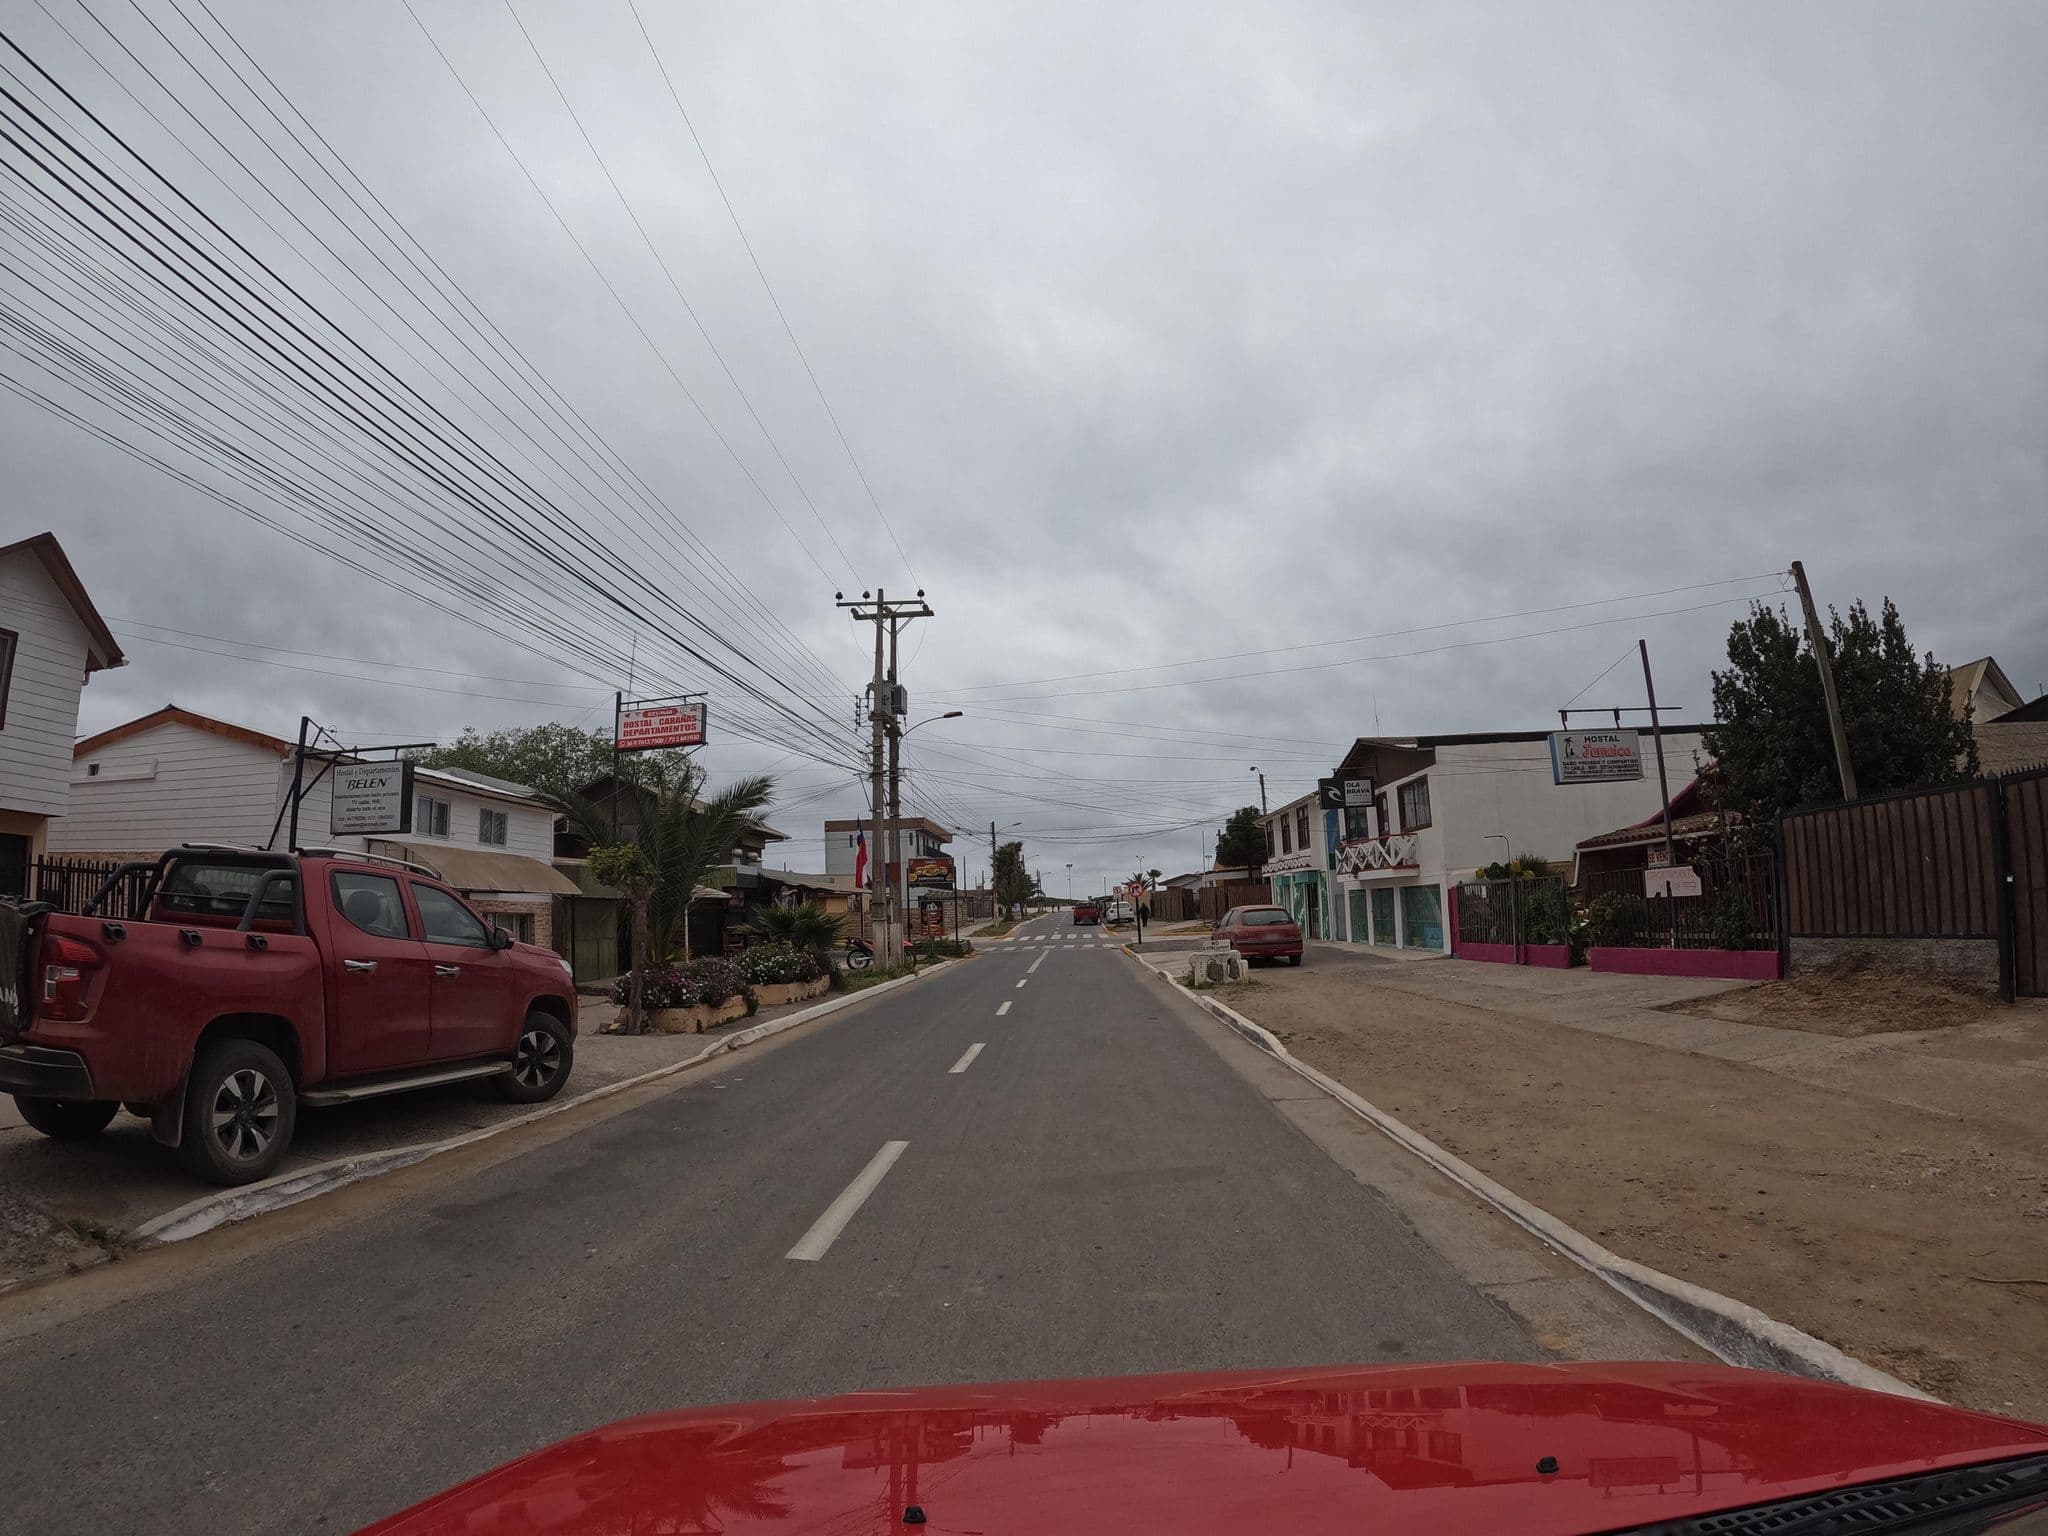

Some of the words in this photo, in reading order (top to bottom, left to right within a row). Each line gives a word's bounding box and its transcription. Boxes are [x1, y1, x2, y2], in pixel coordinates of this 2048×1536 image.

[623, 720, 652, 729] HOSTAL
[623, 722, 697, 737] DEPARTAMENTOS
[1584, 735, 1620, 743] HOSTAL
[1582, 744, 1632, 759] Jamaica
